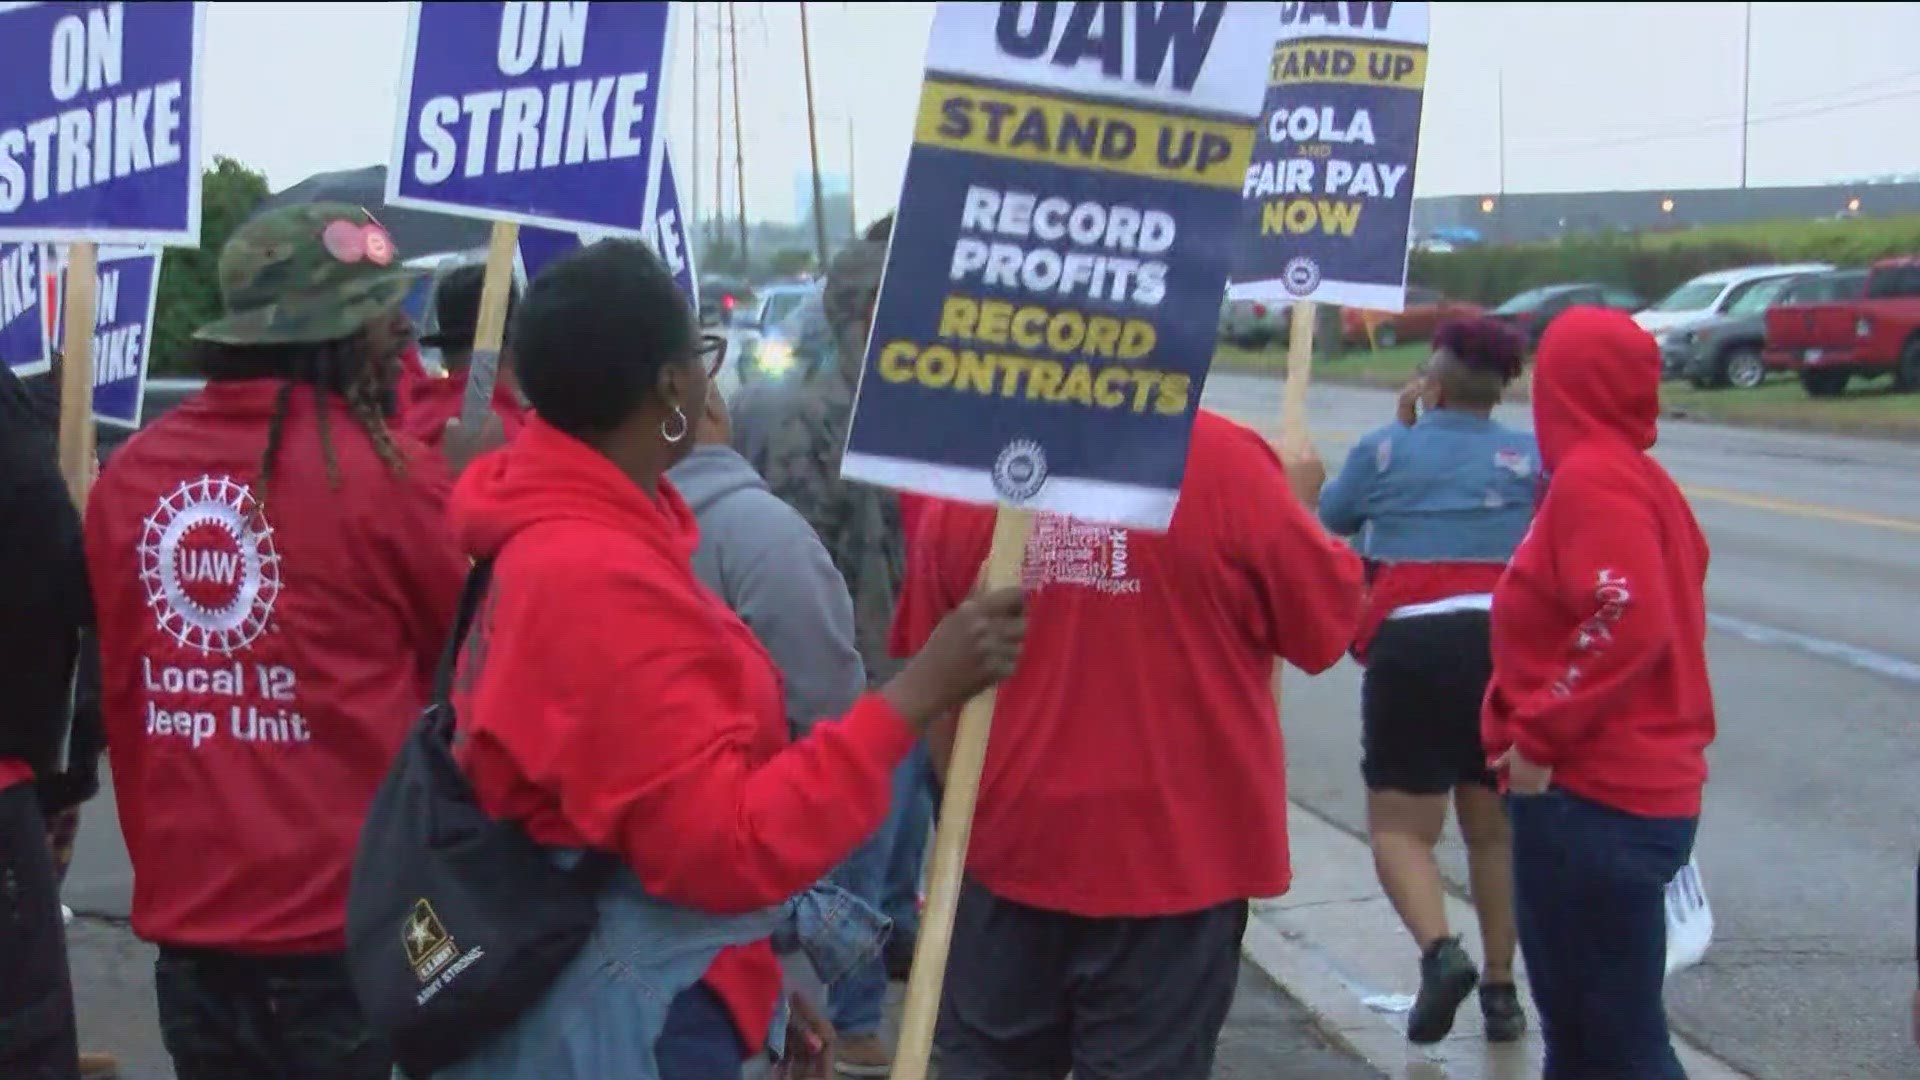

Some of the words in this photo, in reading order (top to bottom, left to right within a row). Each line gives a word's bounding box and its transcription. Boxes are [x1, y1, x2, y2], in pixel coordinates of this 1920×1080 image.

[50, 7, 124, 100] ON
[497, 2, 588, 76] ON
[995, 2, 1227, 94] UAW
[1271, 49, 1356, 79] TAND
[1368, 52, 1415, 80] UP
[0, 80, 181, 213] STRIKE
[414, 72, 648, 185] STRIKE
[939, 97, 1137, 160] STAND
[1157, 125, 1232, 172] UP
[1269, 106, 1375, 145] COLA
[1243, 159, 1315, 200] FAIR
[1325, 160, 1407, 199] PAY
[961, 184, 1176, 252] RECORD
[1261, 200, 1362, 236] NOW
[0, 240, 37, 332] KE
[95, 269, 119, 326] N
[950, 239, 1169, 304] PROFITS
[93, 323, 141, 388] IKE
[939, 296, 1156, 358] RECORD
[879, 341, 1191, 415] CONTRACTS
[181, 550, 238, 584] UAW
[144, 656, 243, 696] Local
[257, 664, 296, 700] 12
[147, 701, 216, 748] Jeep
[231, 706, 310, 742] Unit
